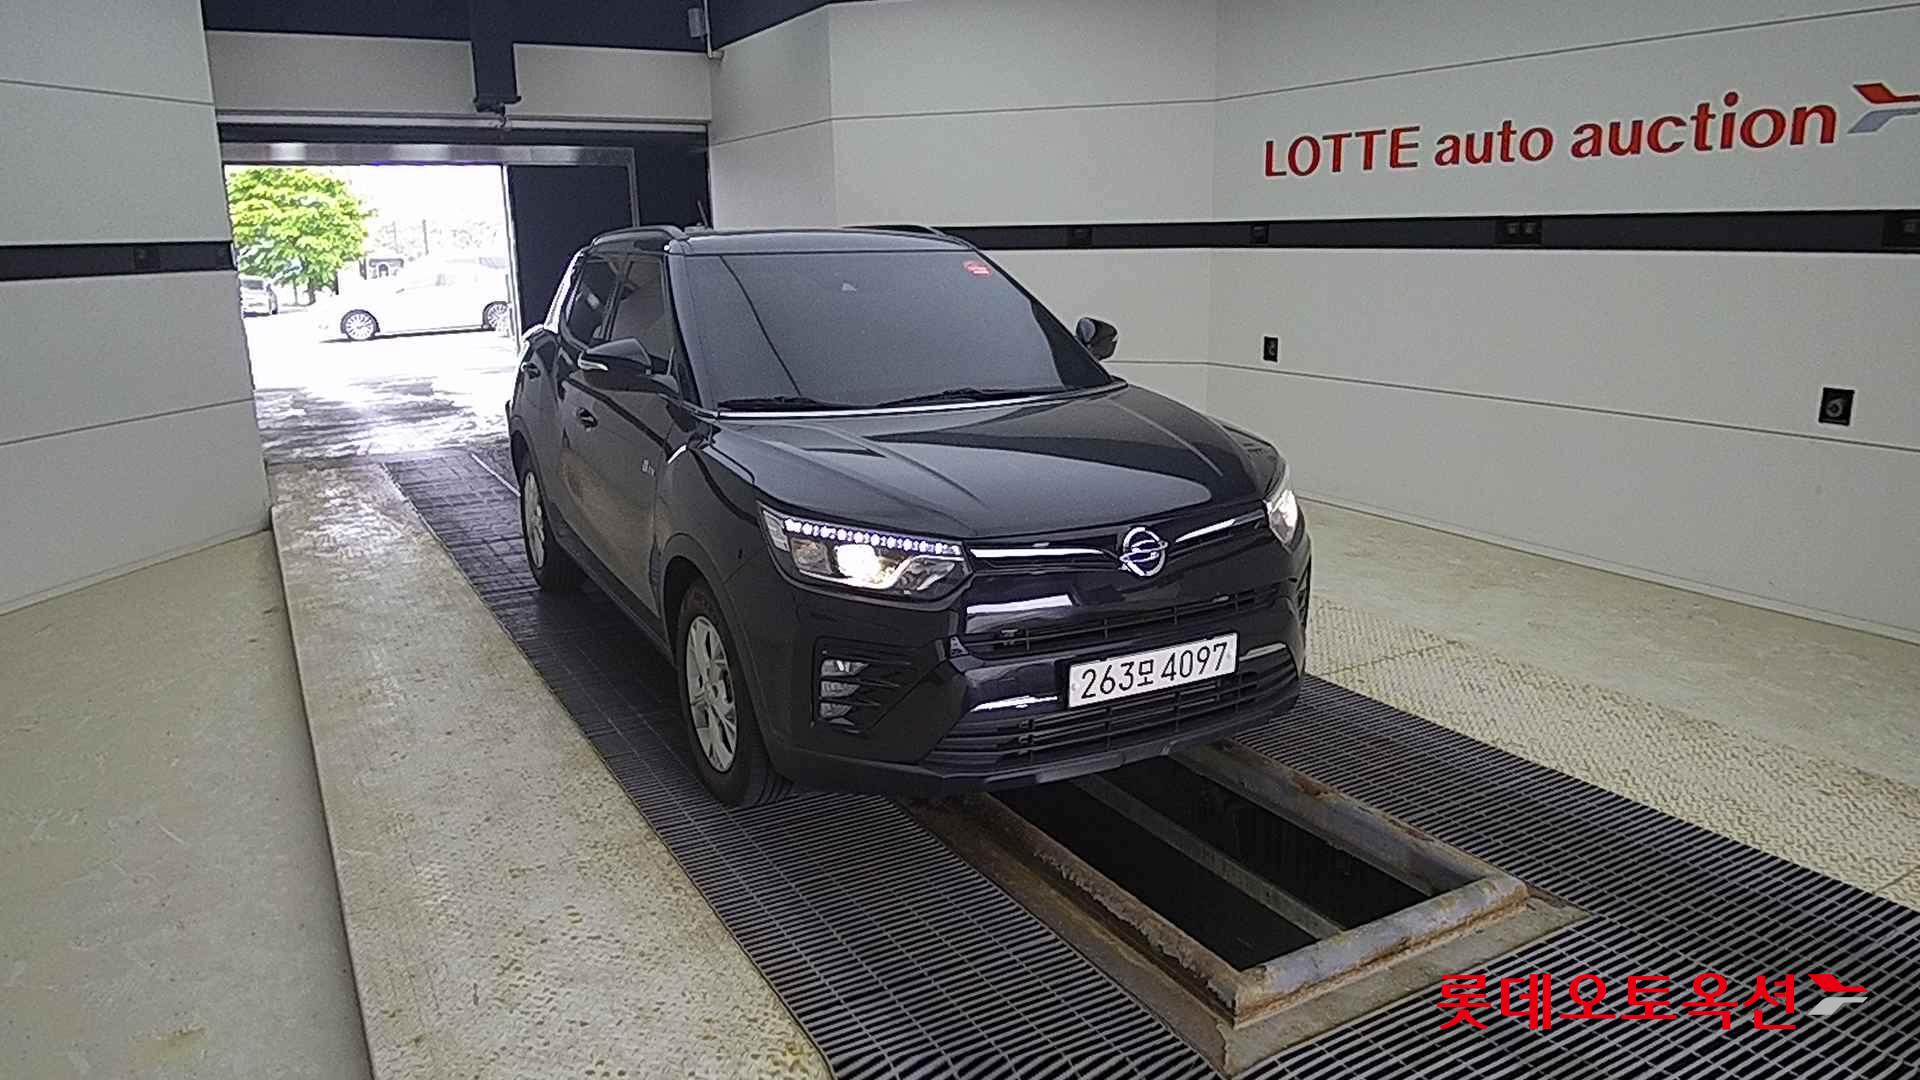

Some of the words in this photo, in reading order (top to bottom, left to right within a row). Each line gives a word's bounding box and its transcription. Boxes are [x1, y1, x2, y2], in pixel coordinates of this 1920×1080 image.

[1264, 126, 1421, 177] LOTTE
[1434, 122, 1554, 168] auto
[1570, 92, 1838, 160] auction
